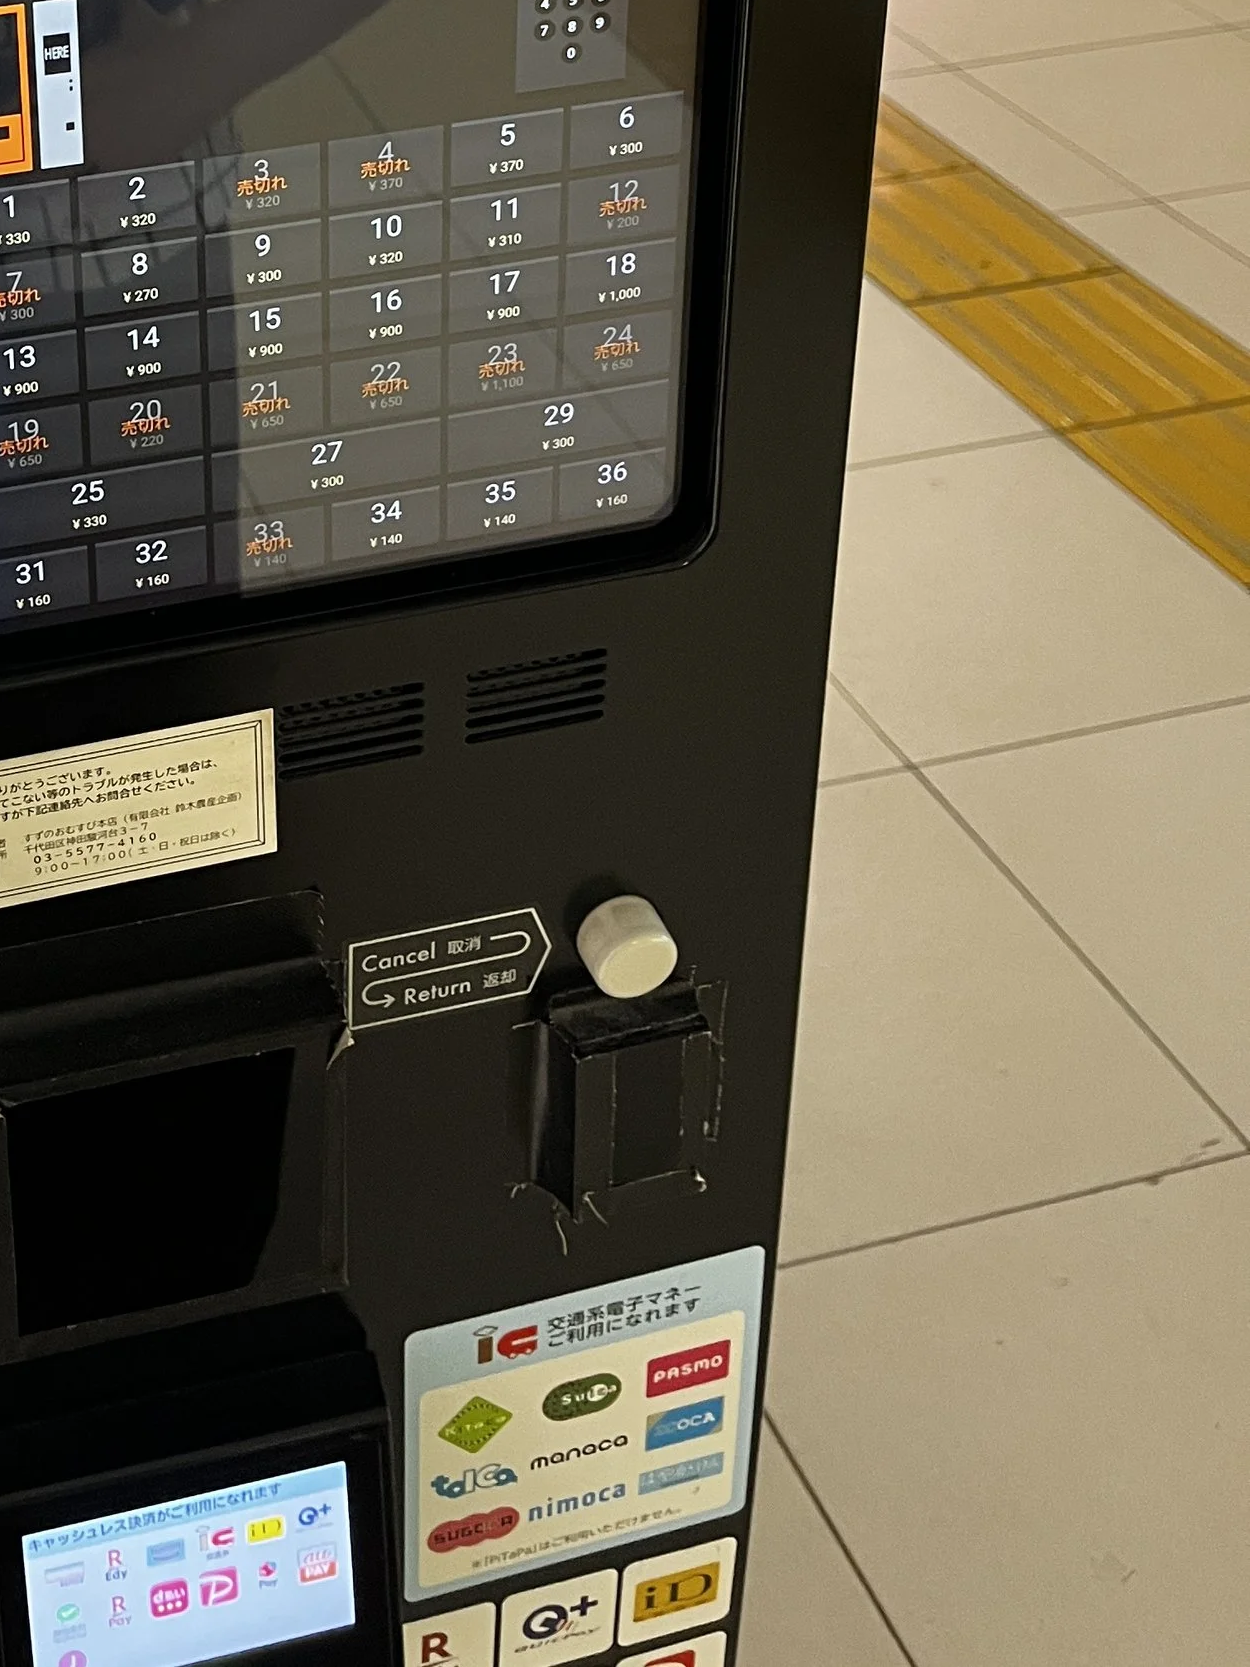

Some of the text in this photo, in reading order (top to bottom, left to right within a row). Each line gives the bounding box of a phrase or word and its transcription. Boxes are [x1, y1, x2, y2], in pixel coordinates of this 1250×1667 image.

[540, 17, 605, 37] 7 8 9
[43, 44, 70, 61] HERE
[566, 46, 576, 59] 0
[619, 105, 635, 128] 6
[500, 123, 516, 147] 5
[378, 141, 394, 162] 4
[253, 159, 269, 180] 3
[128, 176, 146, 200] 2
[609, 180, 639, 202] 12
[2, 195, 15, 218] 1
[490, 197, 518, 221] 11
[370, 214, 403, 239] 10
[255, 234, 271, 257] 9
[131, 252, 148, 275] 8
[606, 252, 636, 276] 18
[6, 271, 23, 293] 7
[489, 270, 520, 295] 17
[370, 288, 403, 313] 16
[249, 307, 281, 332] 15
[126, 325, 161, 351] 14
[603, 324, 633, 347] 24
[3, 345, 36, 370] 13
[488, 343, 518, 366] 23
[370, 361, 401, 384] 22
[250, 380, 278, 404] 21
[129, 399, 162, 423] 20
[544, 402, 574, 427] 29
[8, 418, 40, 442] 19
[311, 440, 343, 466] 27
[597, 461, 628, 485] 36
[70, 480, 105, 505] 25
[484, 480, 517, 505] 35
[370, 500, 403, 525] 34
[254, 520, 285, 543] 33
[134, 540, 169, 565] 32
[15, 560, 45, 585] 31
[361, 935, 482, 972] Cancel 取消
[404, 968, 517, 1005] Return 返却
[547, 1285, 702, 1333] 交通系電子マネー
[547, 1297, 701, 1348] ご利用になれます
[653, 1354, 723, 1384] PASMO
[531, 1434, 629, 1471] manaca
[528, 1483, 626, 1522] nimoca
